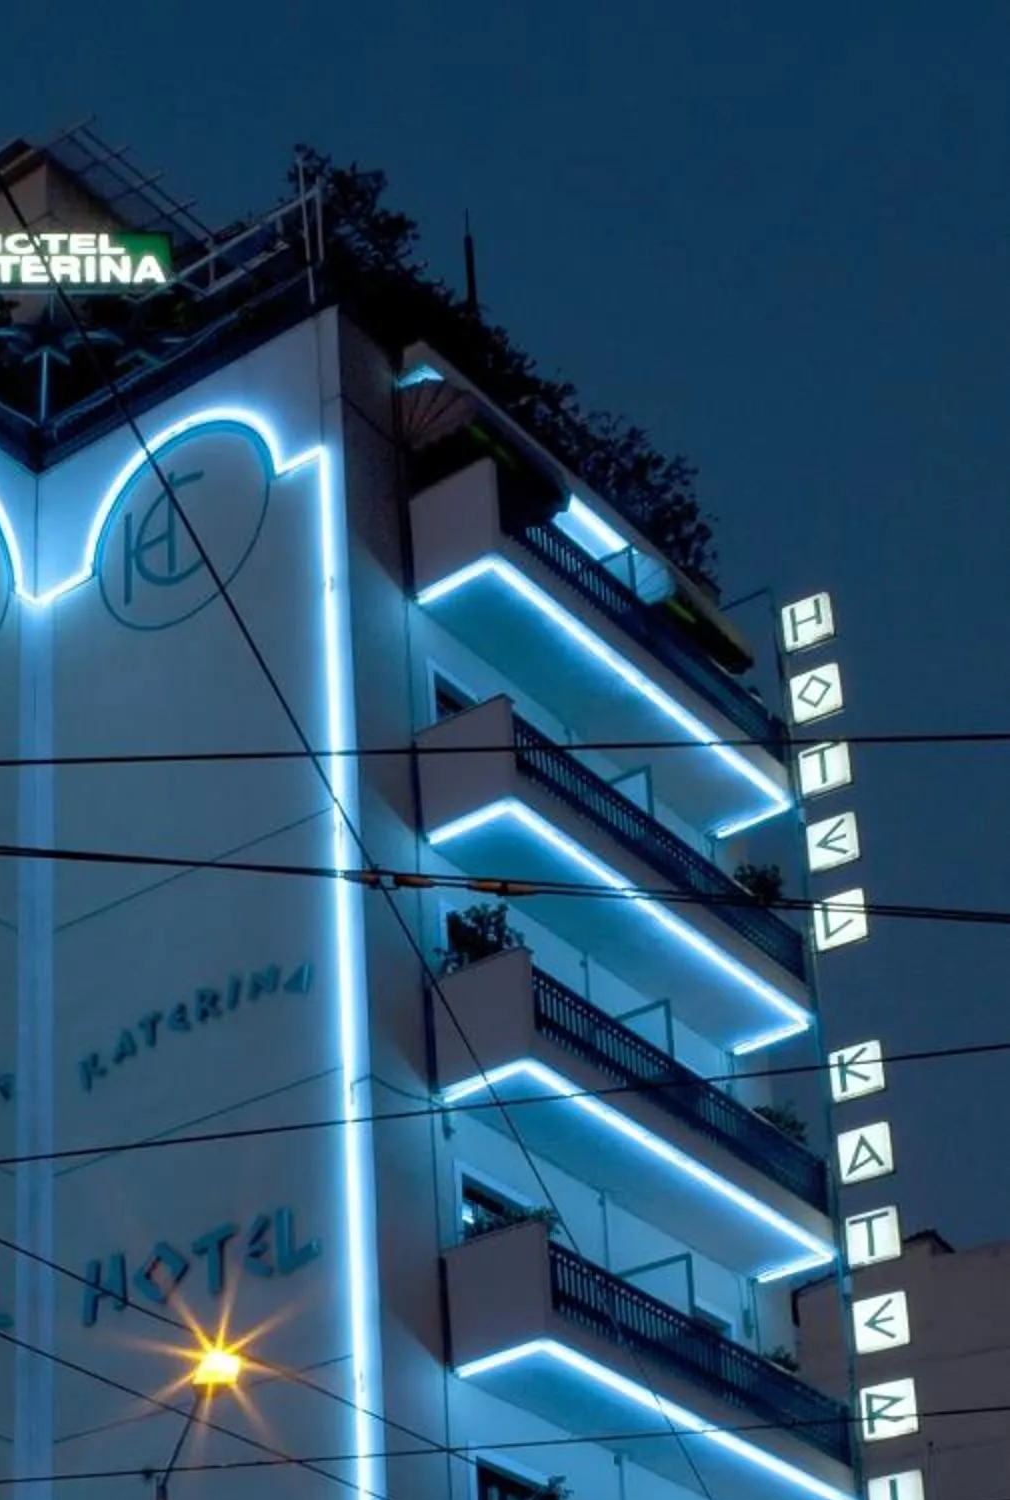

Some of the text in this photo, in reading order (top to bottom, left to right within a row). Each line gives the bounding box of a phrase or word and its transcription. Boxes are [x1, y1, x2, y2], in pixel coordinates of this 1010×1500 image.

[787, 596, 856, 943] HOTEL
[79, 960, 314, 1092] KATERINA
[82, 1206, 323, 1328] HOTEL
